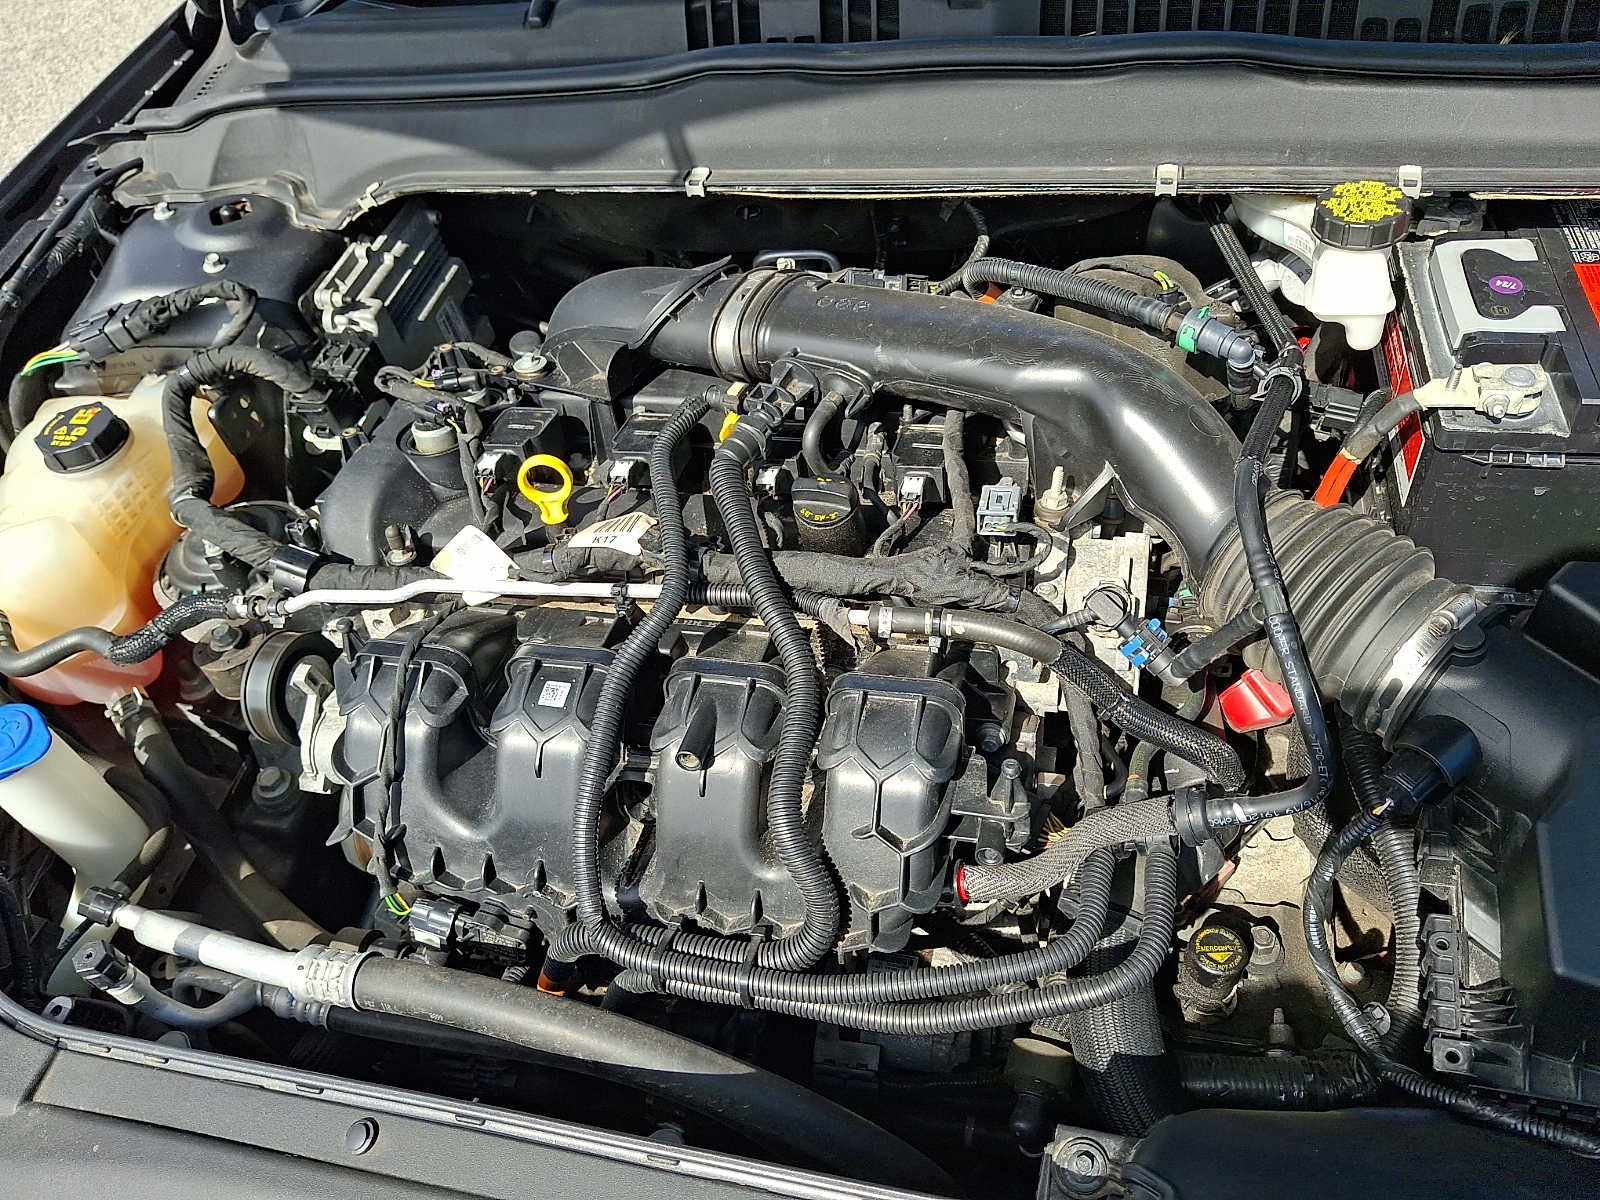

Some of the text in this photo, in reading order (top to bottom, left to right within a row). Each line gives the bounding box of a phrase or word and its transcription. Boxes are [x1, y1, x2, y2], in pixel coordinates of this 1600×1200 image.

[592, 535, 617, 544] K17
[1268, 615, 1290, 656] COOPER
[1285, 660, 1312, 725] STANDARD
